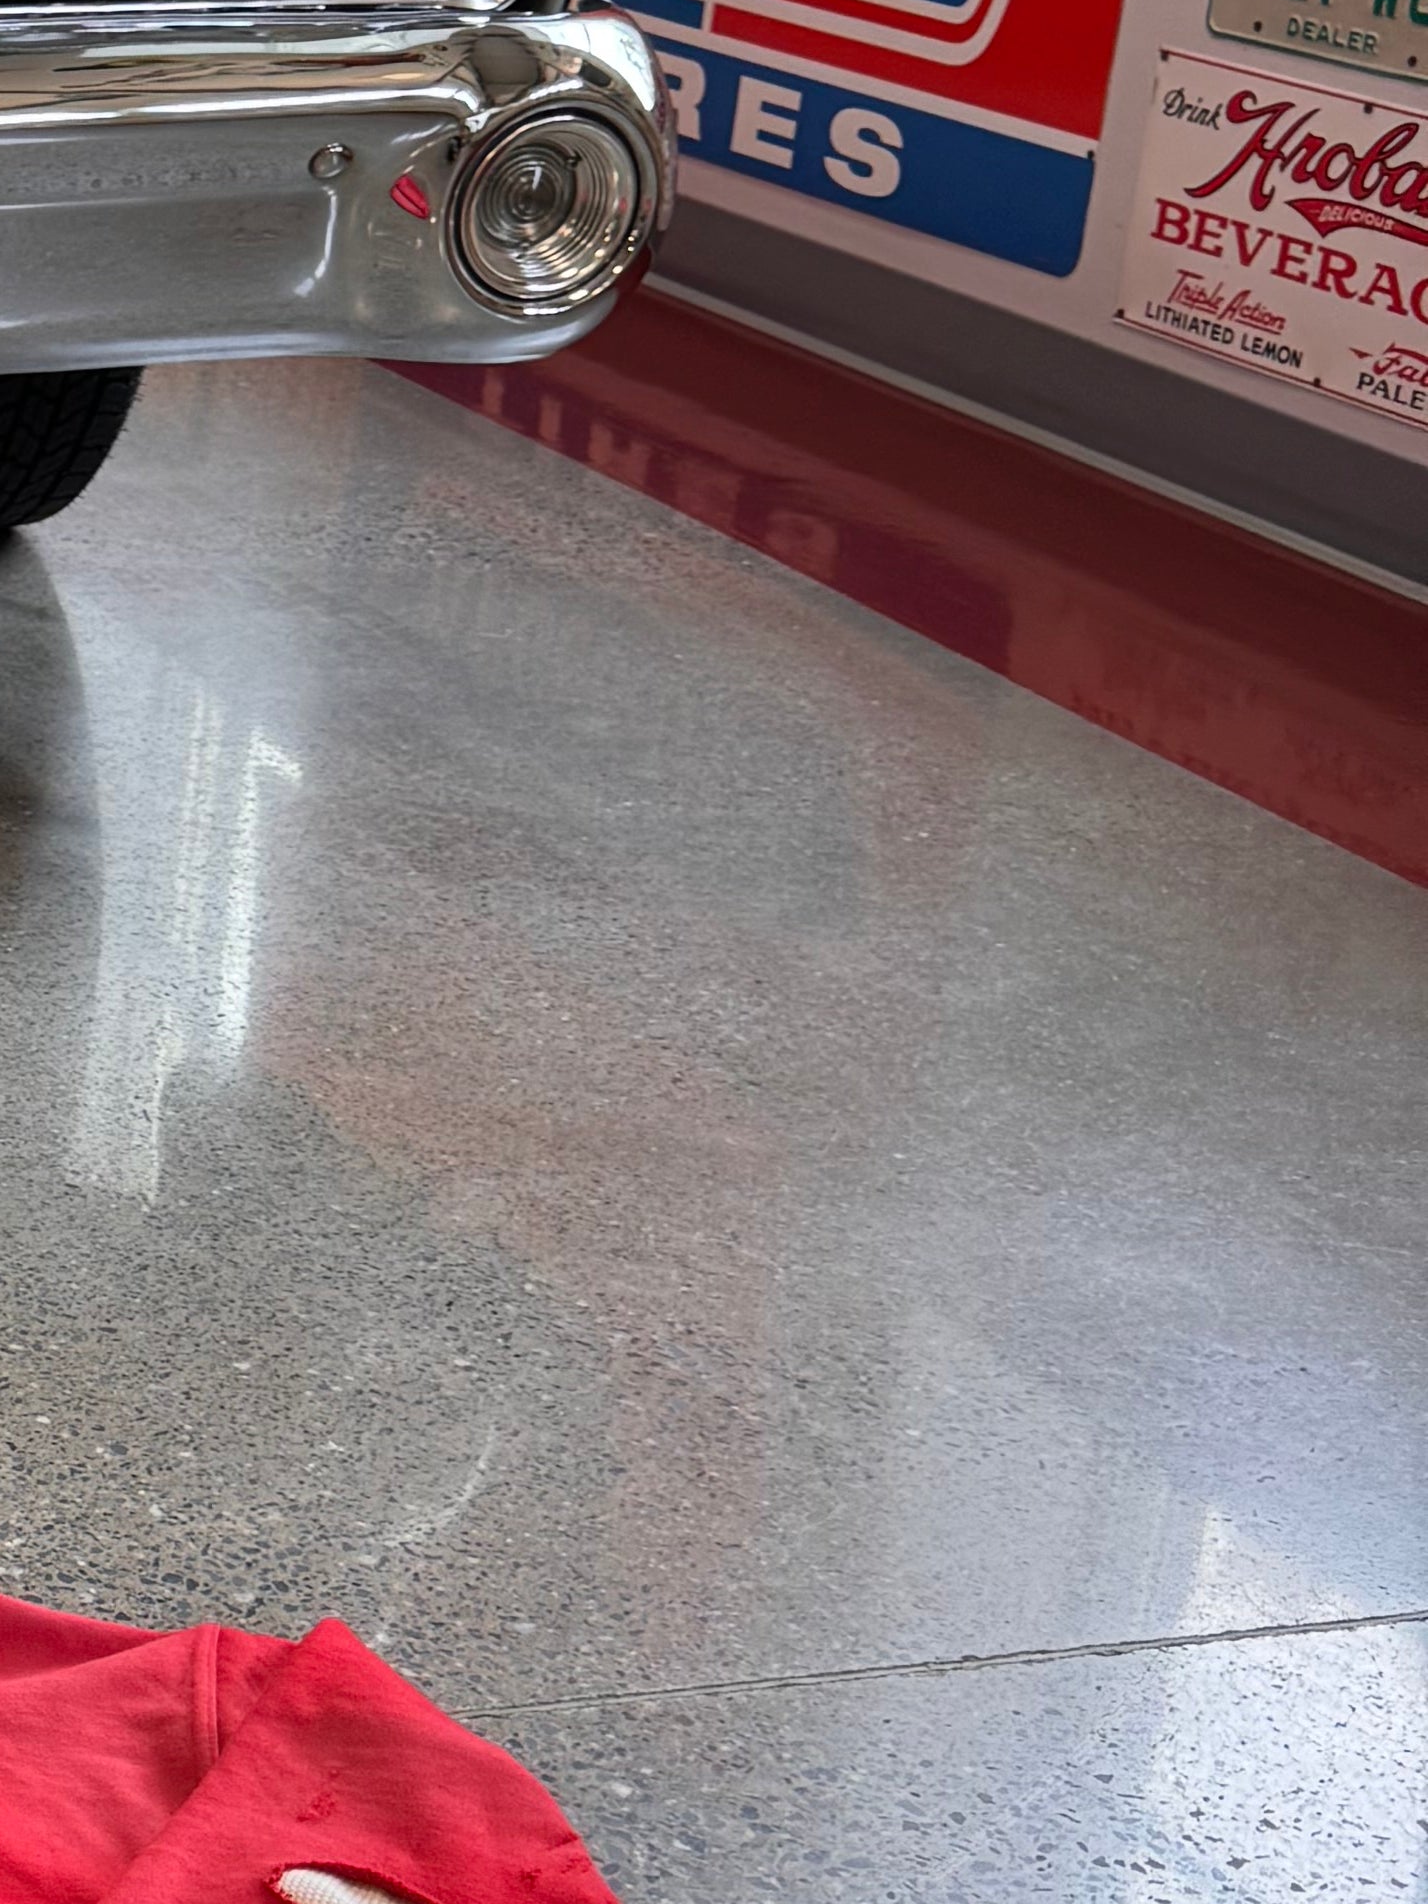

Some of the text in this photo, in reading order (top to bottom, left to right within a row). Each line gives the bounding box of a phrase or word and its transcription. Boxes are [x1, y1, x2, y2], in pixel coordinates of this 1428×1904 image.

[1287, 16, 1379, 55] DEALER
[664, 49, 906, 197] RES
[1162, 87, 1223, 130] Drink
[1168, 269, 1287, 335] Triple Action
[1145, 301, 1304, 370] LITHIATED LEMON
[1356, 372, 1426, 410] PALE
